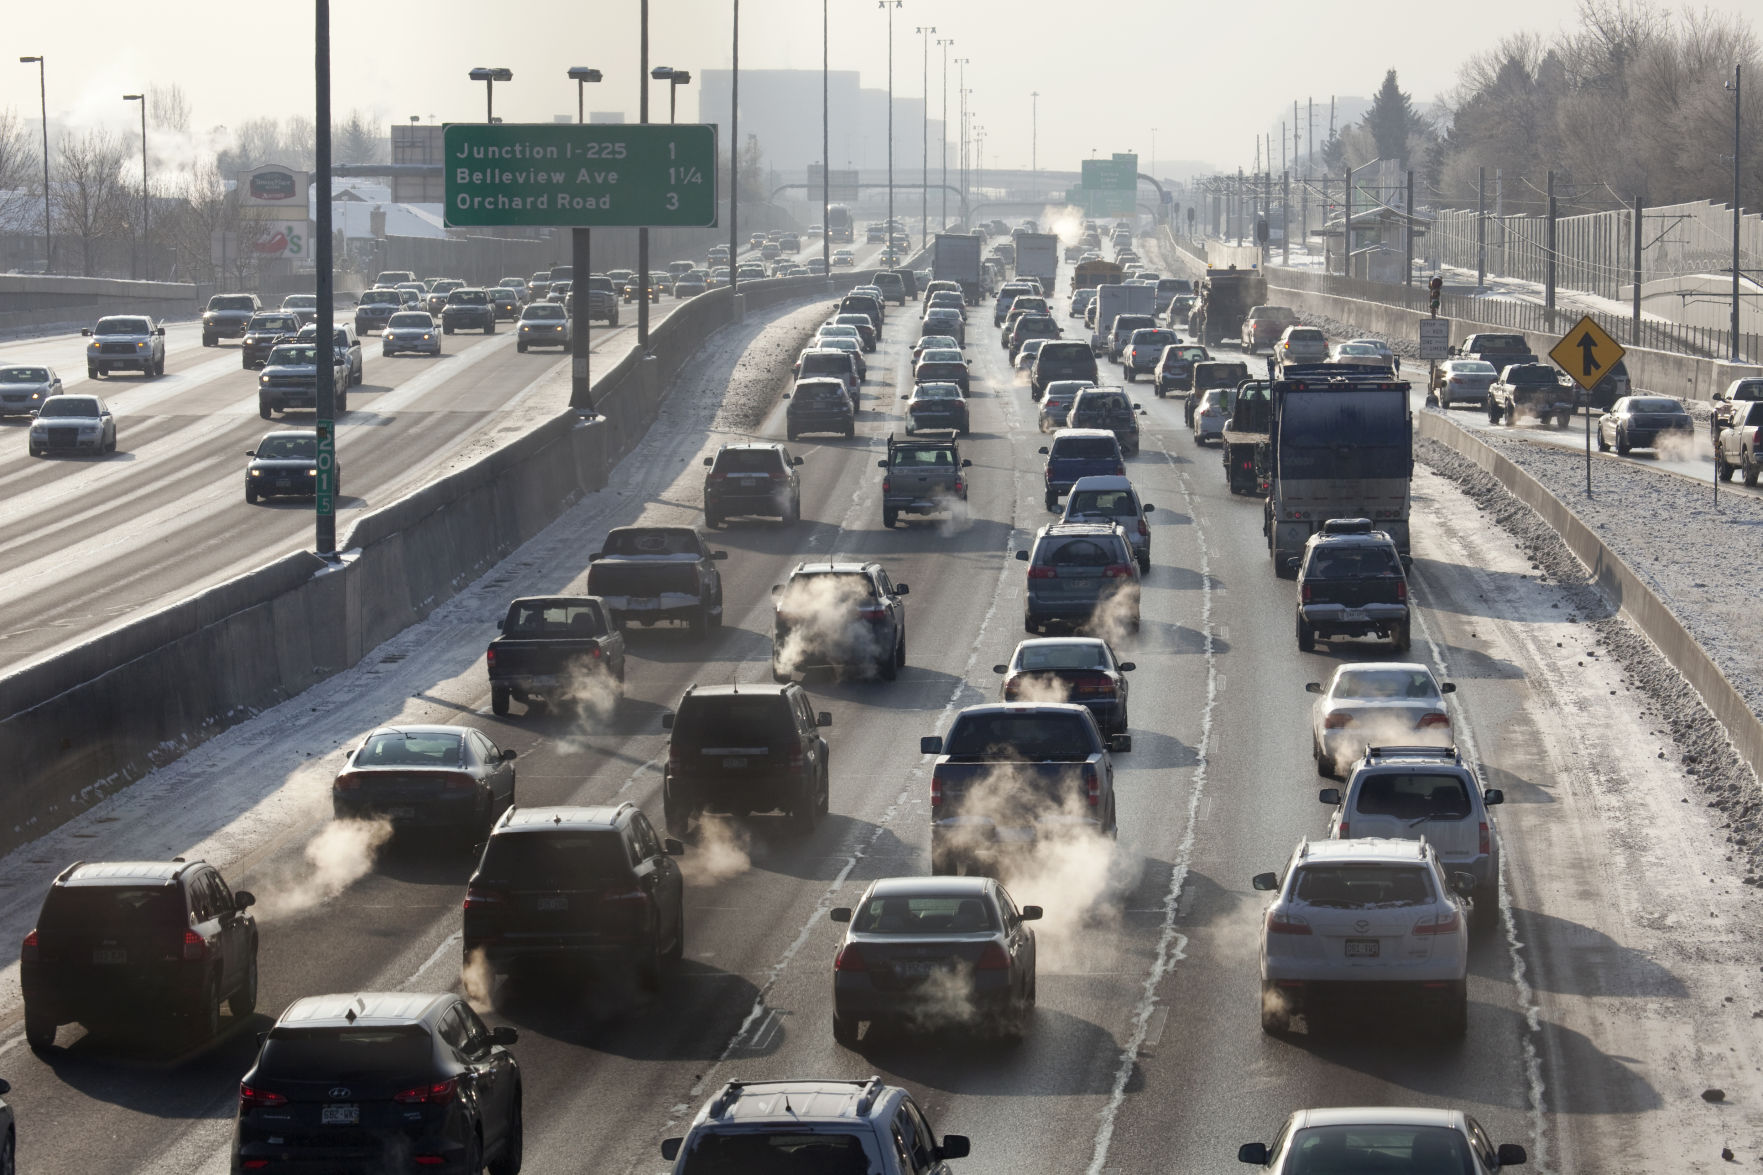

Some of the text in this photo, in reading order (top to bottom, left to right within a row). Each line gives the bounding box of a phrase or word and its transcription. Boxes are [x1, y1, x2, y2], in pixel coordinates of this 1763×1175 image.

[456, 142, 676, 160] Junction I-225 1
[456, 168, 566, 184] Belleview
[575, 168, 618, 184] Ave
[456, 192, 679, 210] Orchard Road 3
